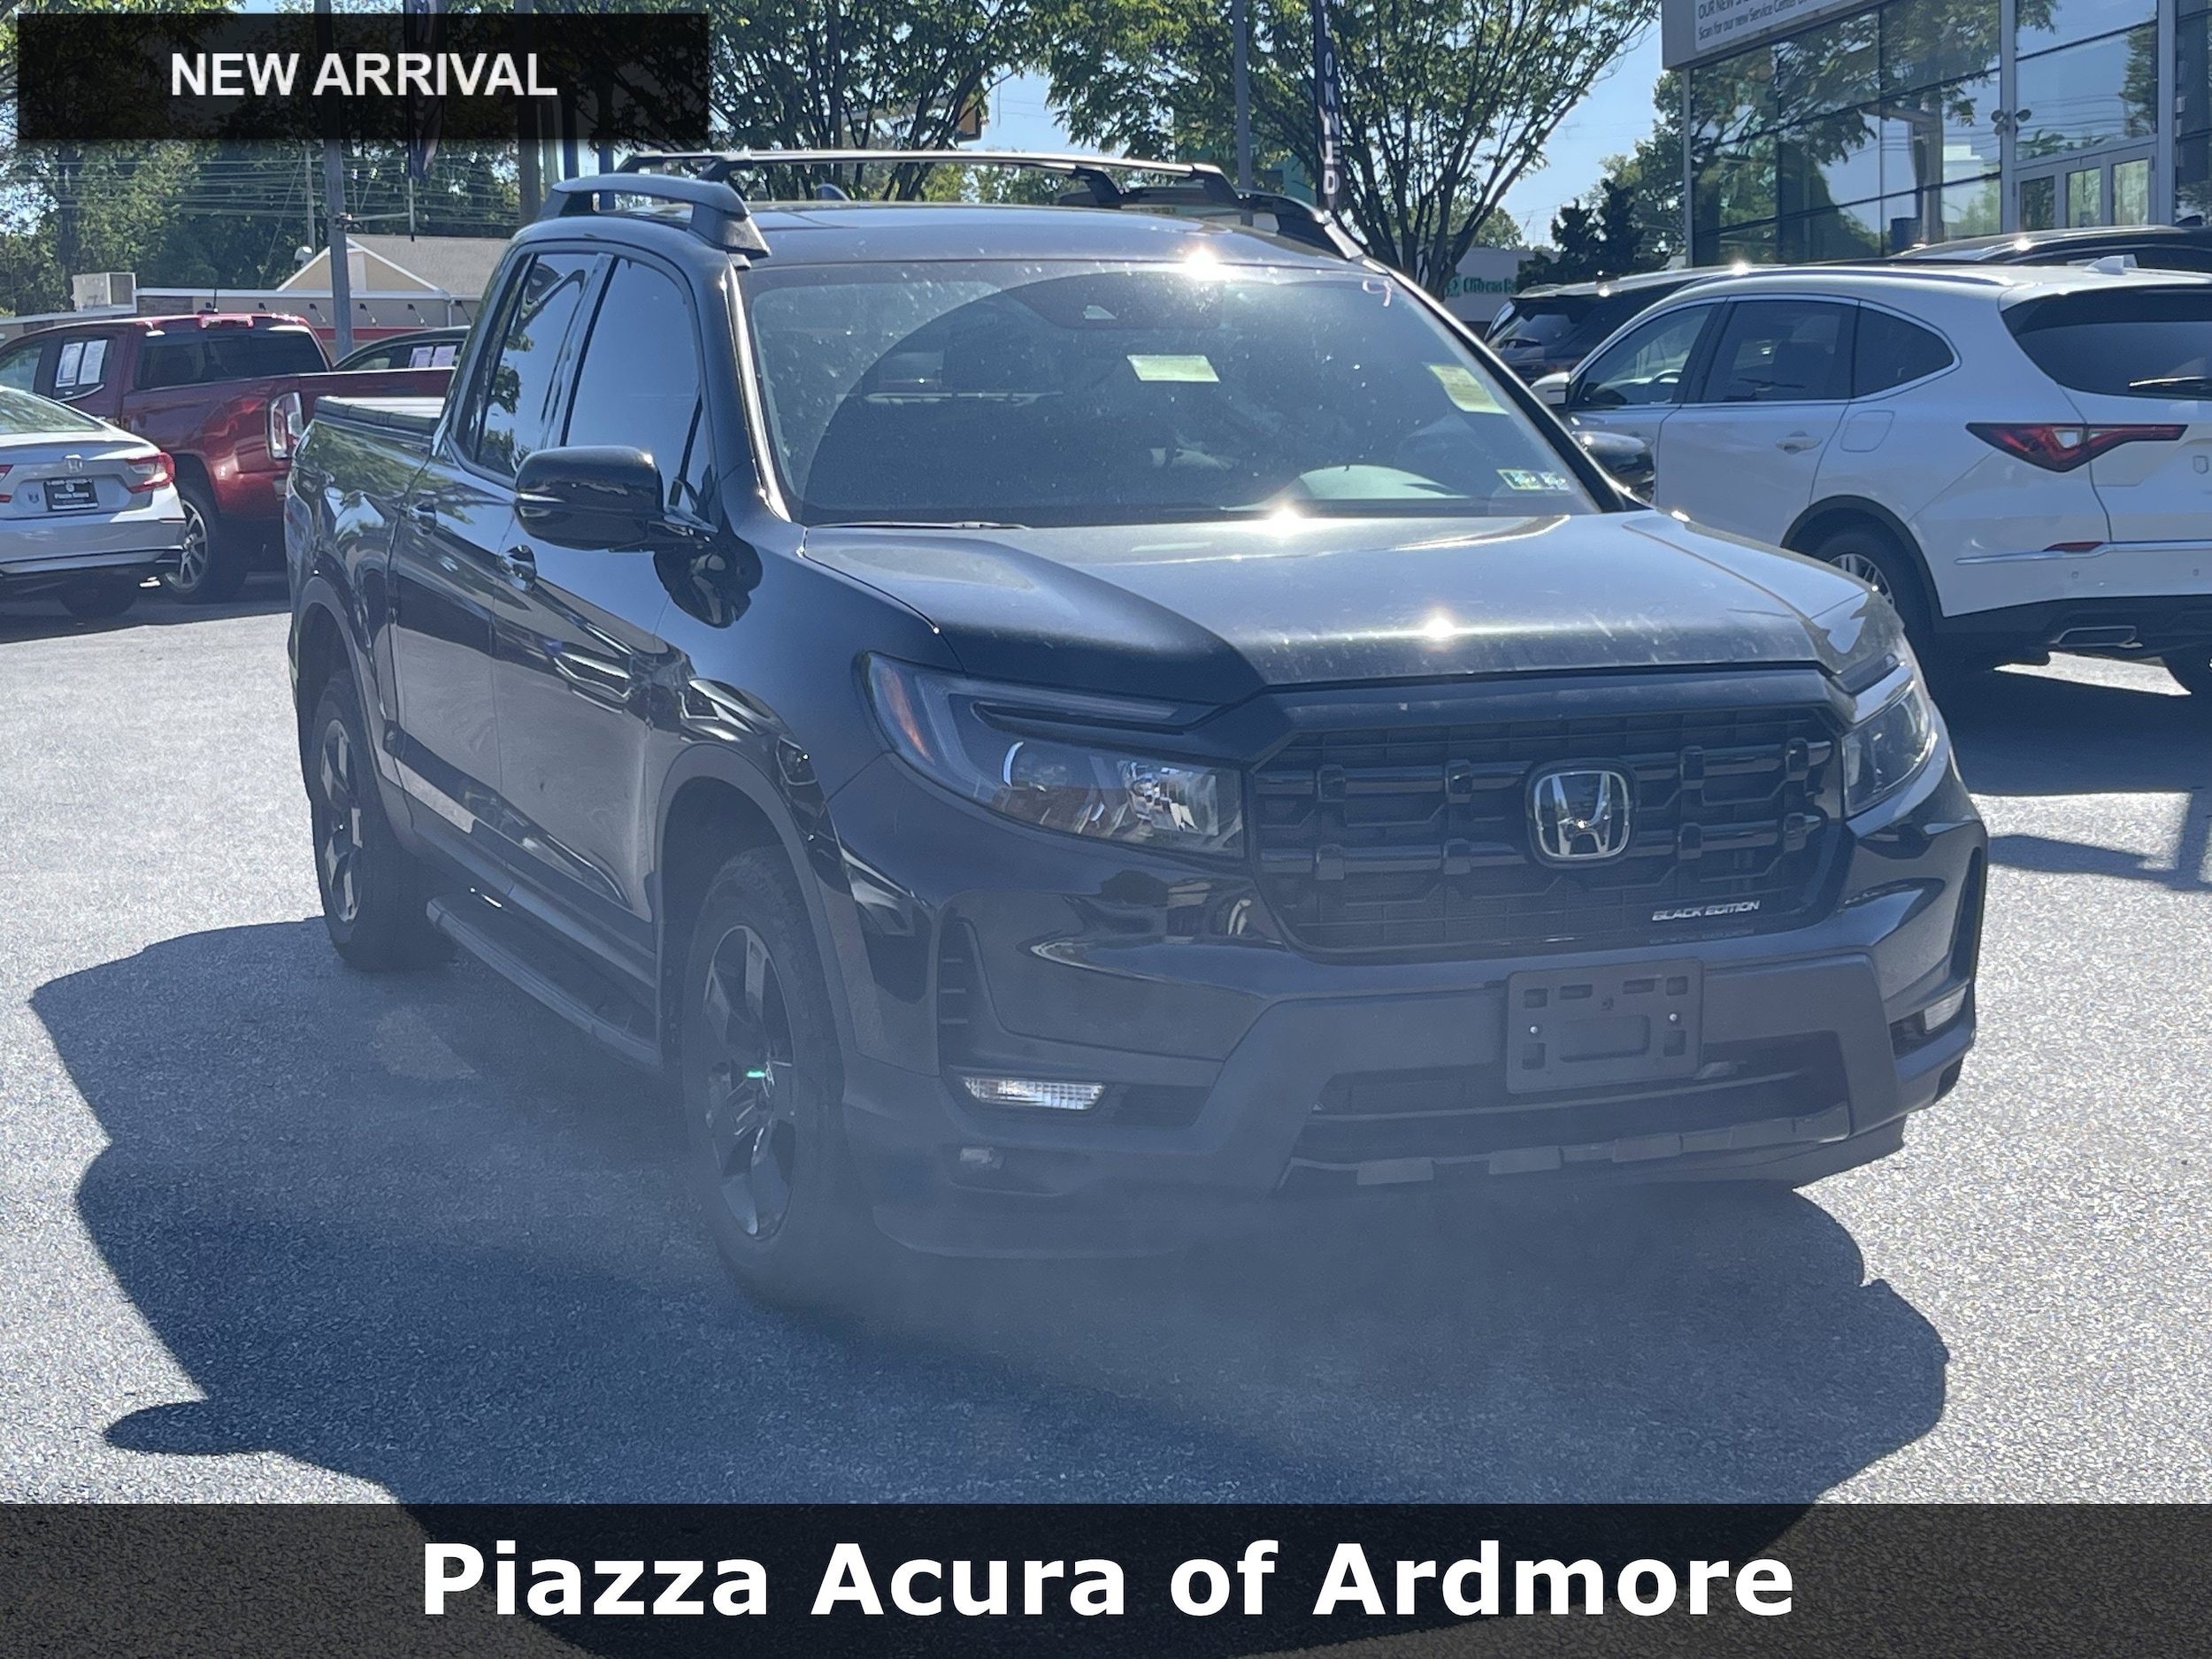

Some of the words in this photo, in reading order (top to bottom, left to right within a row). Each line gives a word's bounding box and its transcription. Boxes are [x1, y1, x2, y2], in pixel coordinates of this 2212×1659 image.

[1749, 7, 1773, 21] Service
[1652, 906, 1704, 921] BLACK
[1704, 900, 1760, 916] EDITION
